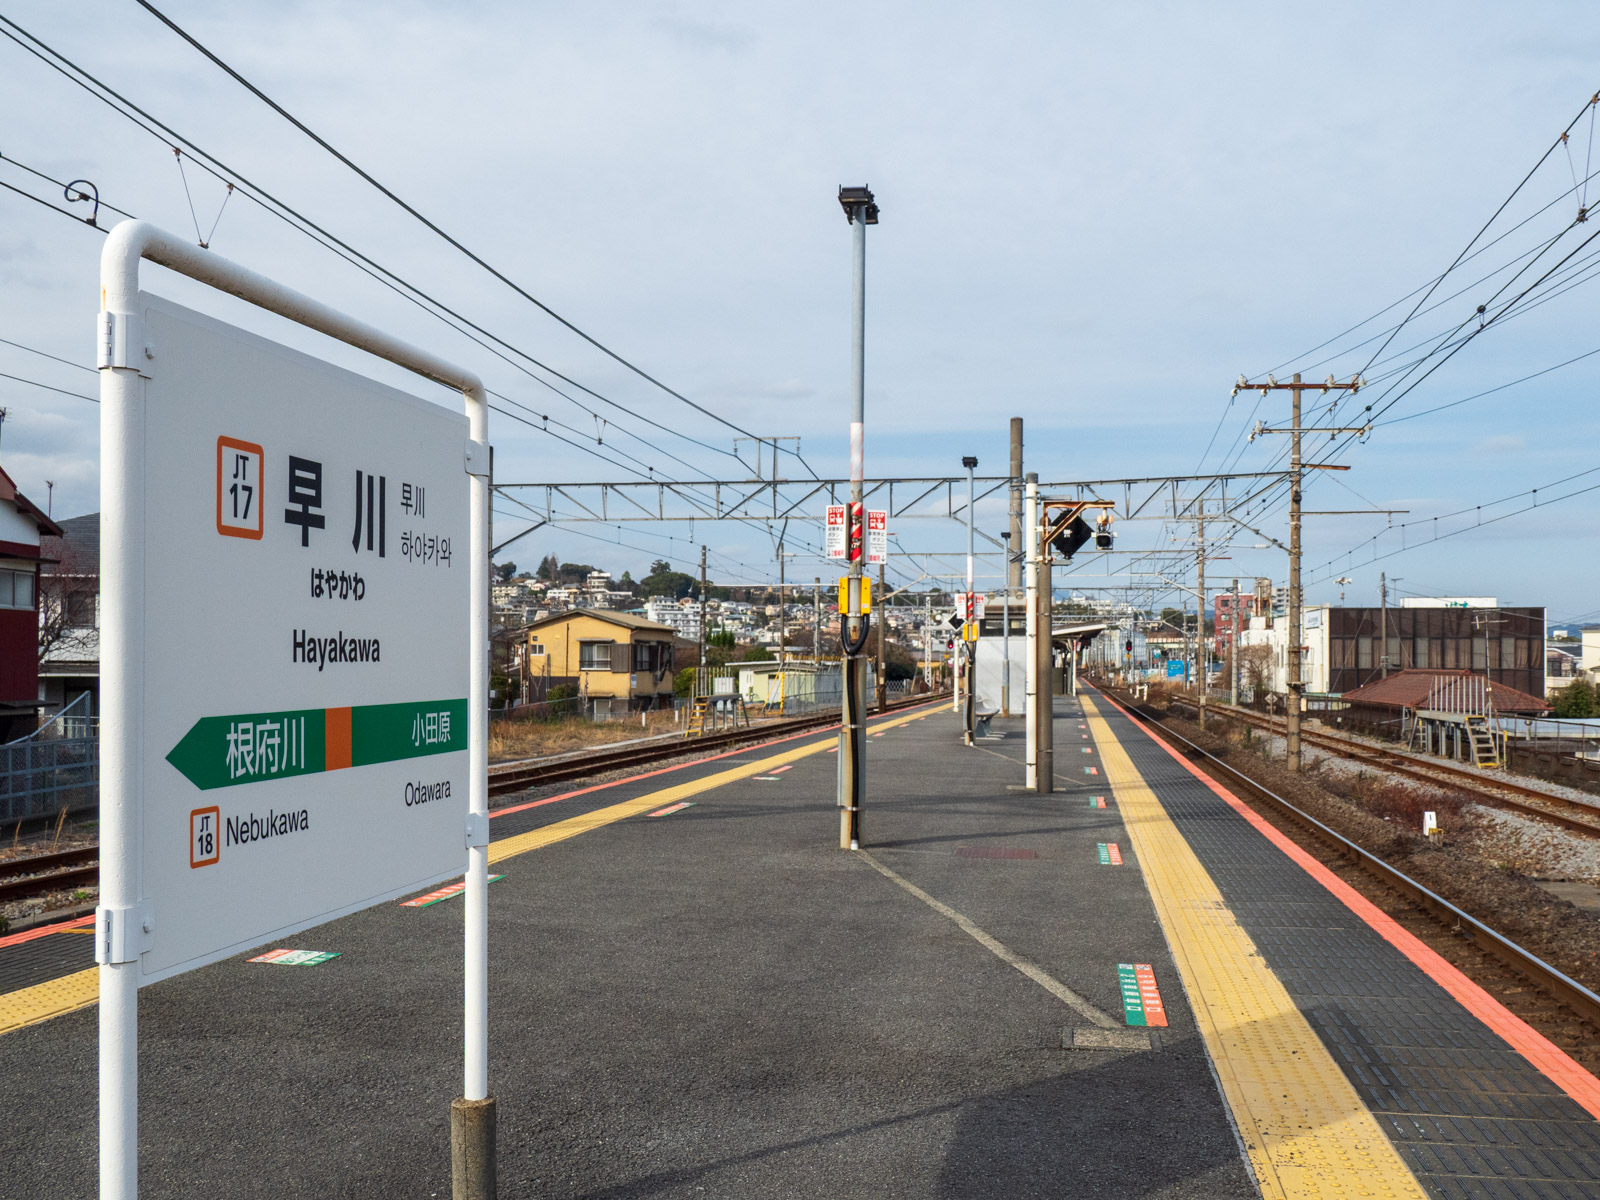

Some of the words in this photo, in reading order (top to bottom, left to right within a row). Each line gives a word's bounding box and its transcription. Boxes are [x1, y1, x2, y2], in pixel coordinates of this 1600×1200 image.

[233, 454, 250, 480] JT
[229, 483, 253, 519] 17
[284, 455, 386, 558] 早川
[400, 482, 425, 519] 早川
[400, 530, 452, 568] 하야카와
[310, 567, 366, 601] はやかわ
[292, 629, 381, 672] Hayakawa
[411, 711, 451, 747] 小田原
[226, 716, 305, 780] 根府川
[404, 780, 452, 807] Odawara
[199, 815, 211, 833] JT
[226, 808, 310, 847] Nebukawa
[197, 832, 214, 856] 18
